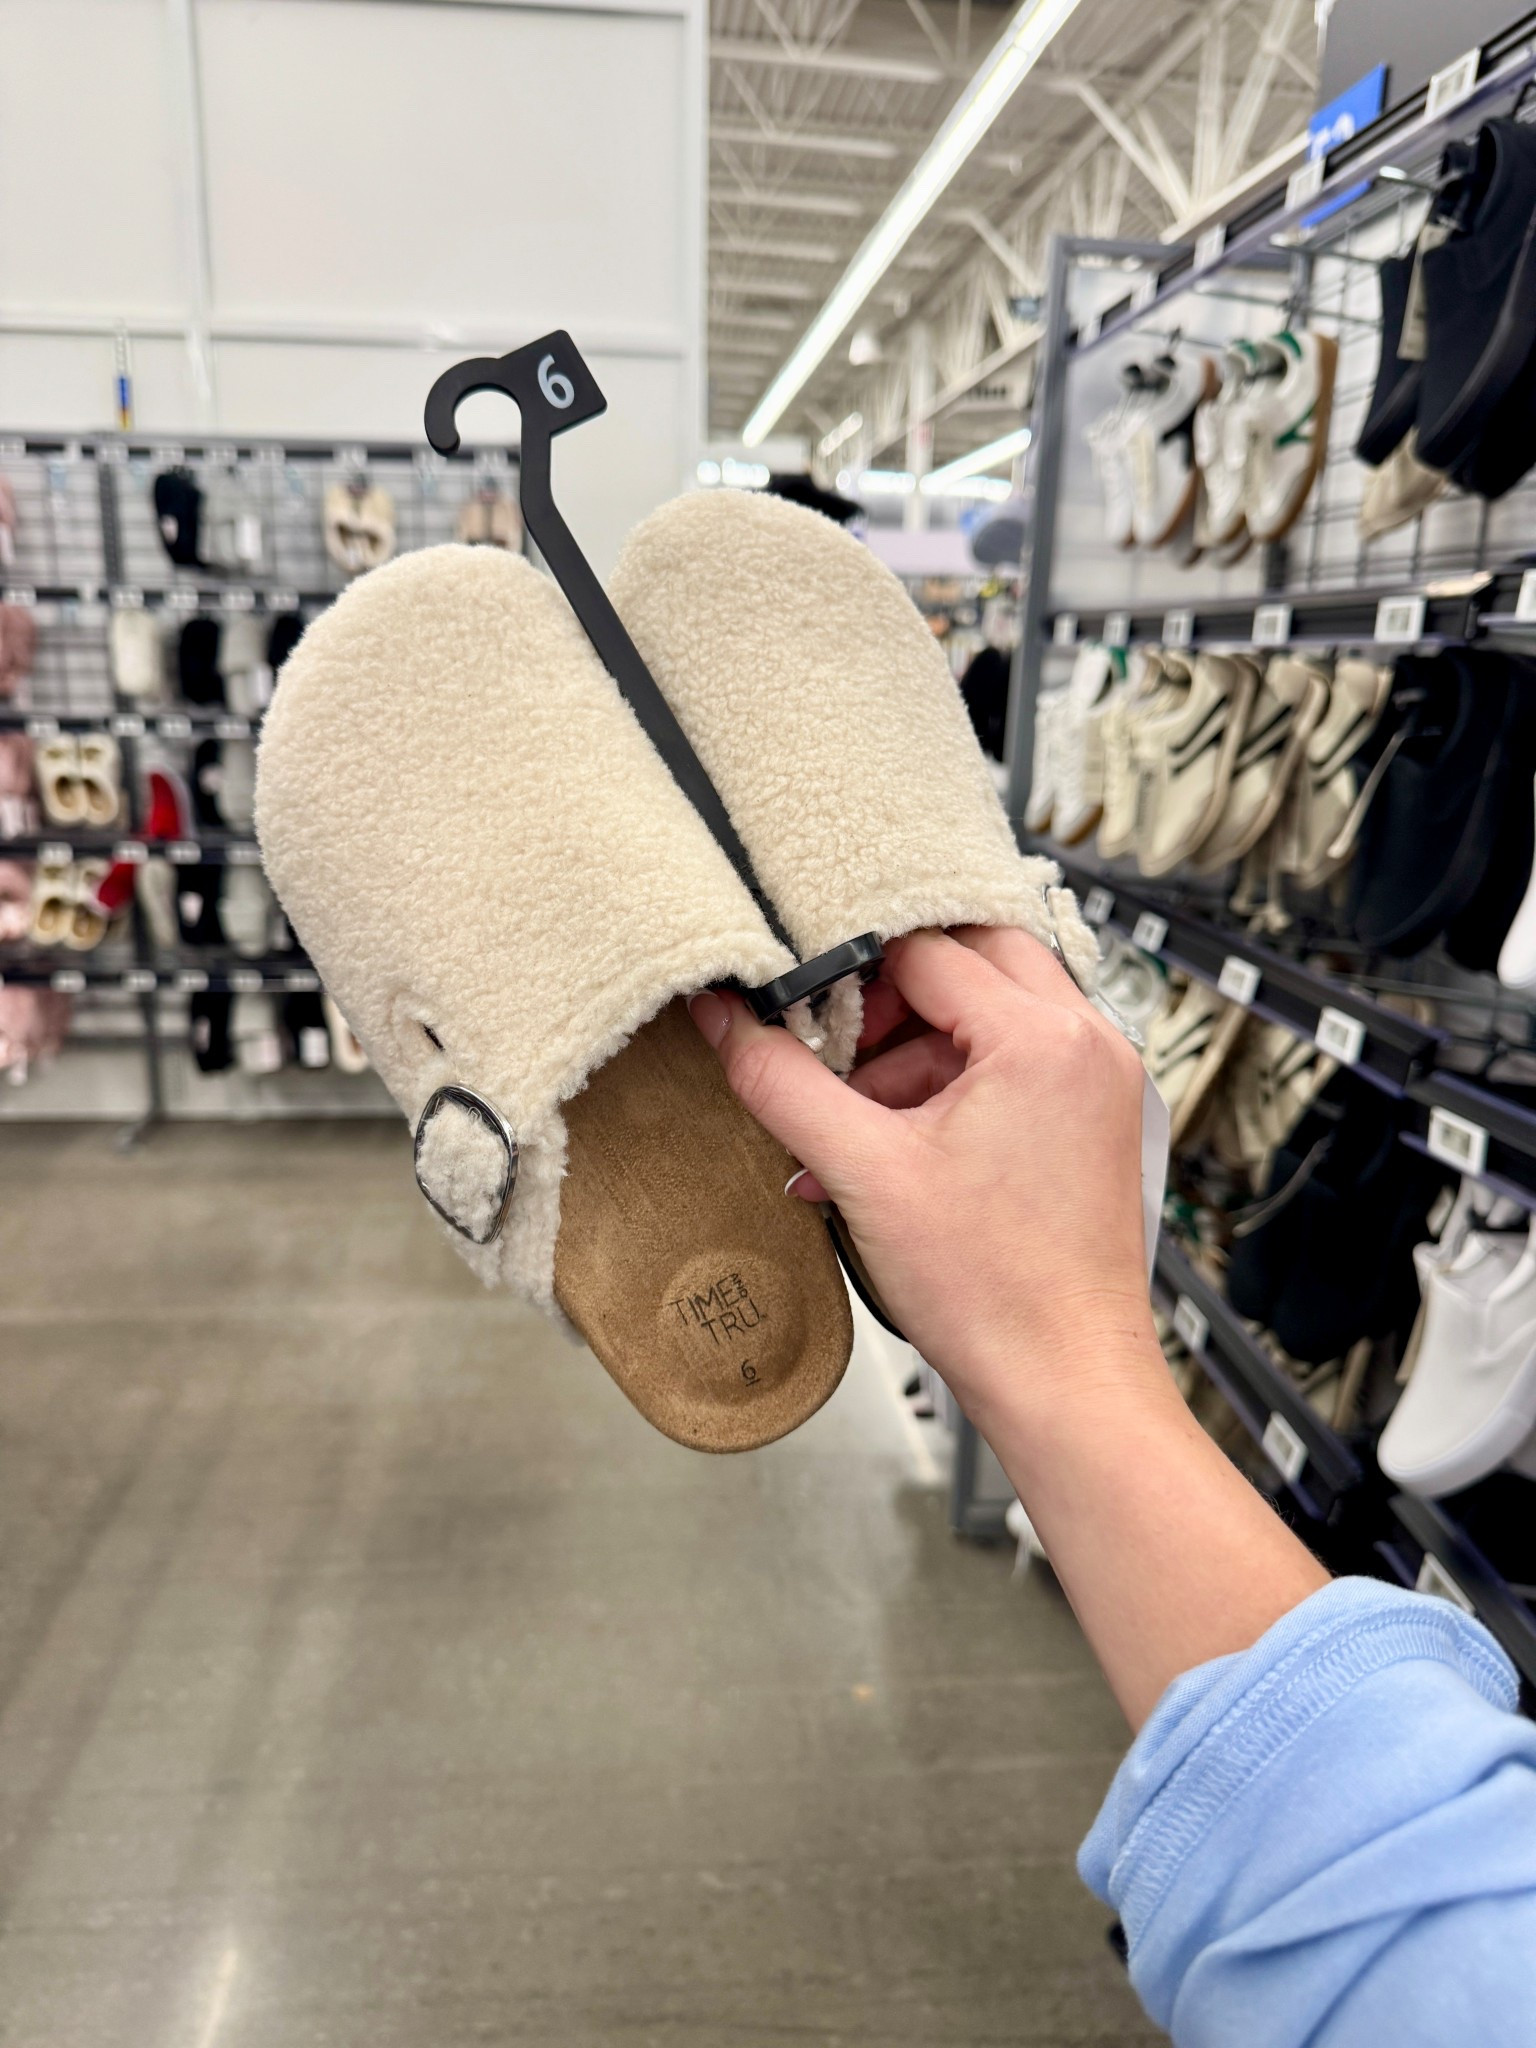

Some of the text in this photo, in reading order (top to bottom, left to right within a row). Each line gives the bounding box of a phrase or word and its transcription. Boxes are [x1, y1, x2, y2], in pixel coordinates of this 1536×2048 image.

[537, 354, 575, 409] 6
[667, 1275, 740, 1326] TIME
[700, 1297, 761, 1346] TRU
[741, 1359, 757, 1380] 6
